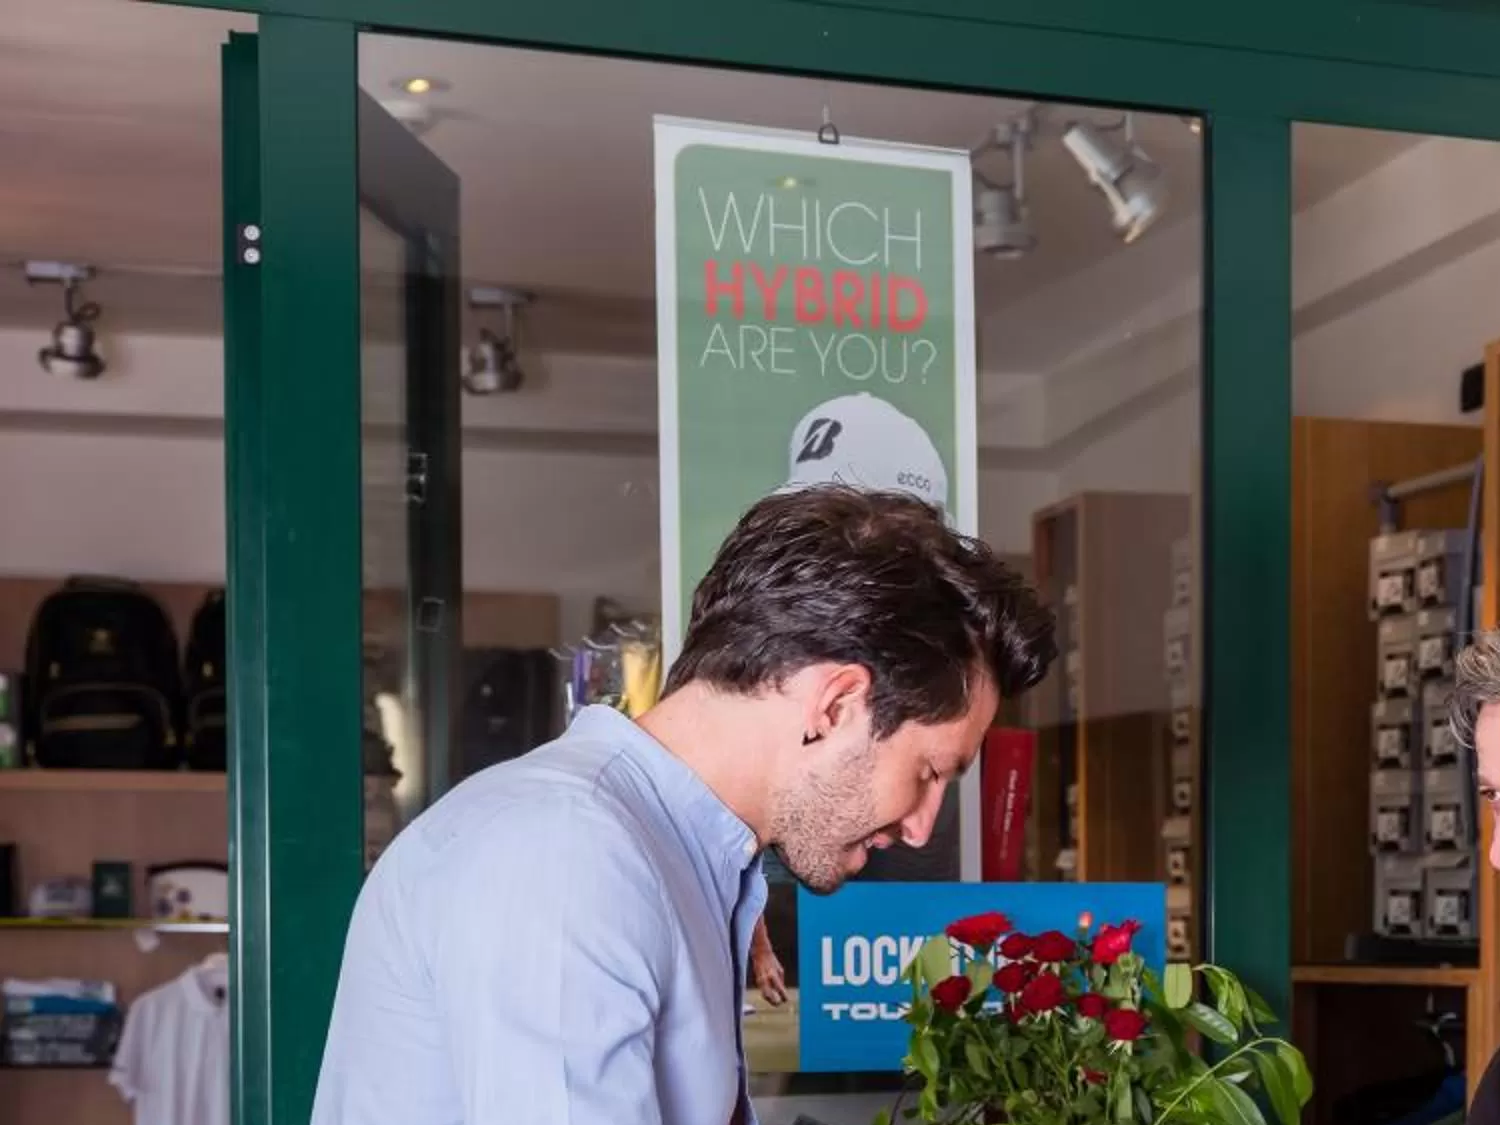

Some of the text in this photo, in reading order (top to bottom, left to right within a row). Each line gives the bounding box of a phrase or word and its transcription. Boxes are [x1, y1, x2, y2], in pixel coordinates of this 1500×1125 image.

[699, 187, 922, 270] WHICH
[704, 259, 928, 334] HYBRID
[700, 323, 937, 385] ARE YOU?
